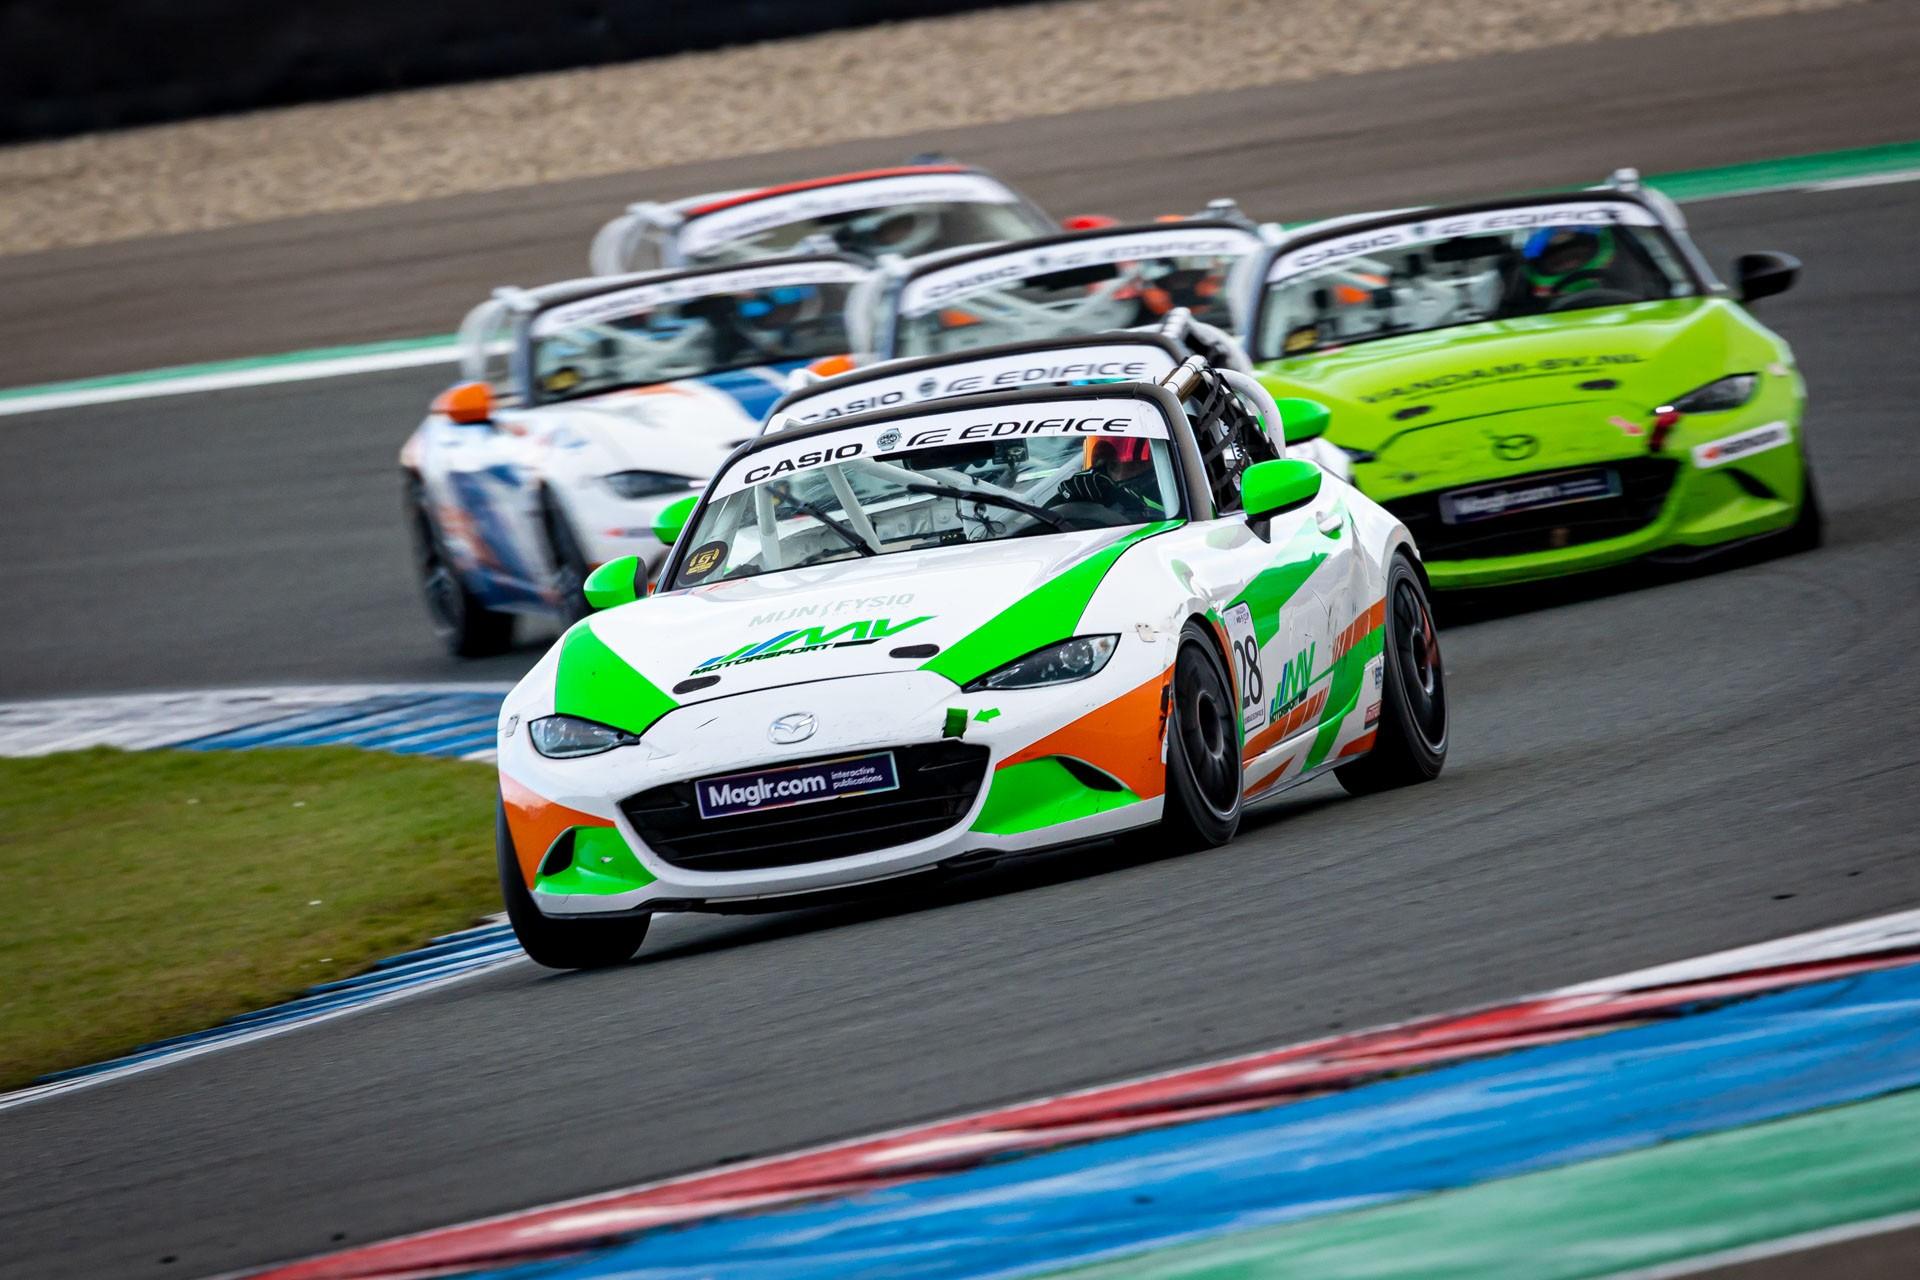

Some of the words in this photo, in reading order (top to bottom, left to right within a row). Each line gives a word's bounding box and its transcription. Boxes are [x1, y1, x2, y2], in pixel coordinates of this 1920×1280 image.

[991, 361, 1146, 386] EDIFICE
[744, 442, 864, 484] CASIO
[958, 418, 1133, 441] EDIFICE
[689, 642, 834, 677] MOTORSPORT
[1233, 634, 1263, 710] 28
[830, 765, 876, 780] interactive
[832, 773, 884, 790] publications
[708, 774, 827, 808] Maglr.com
